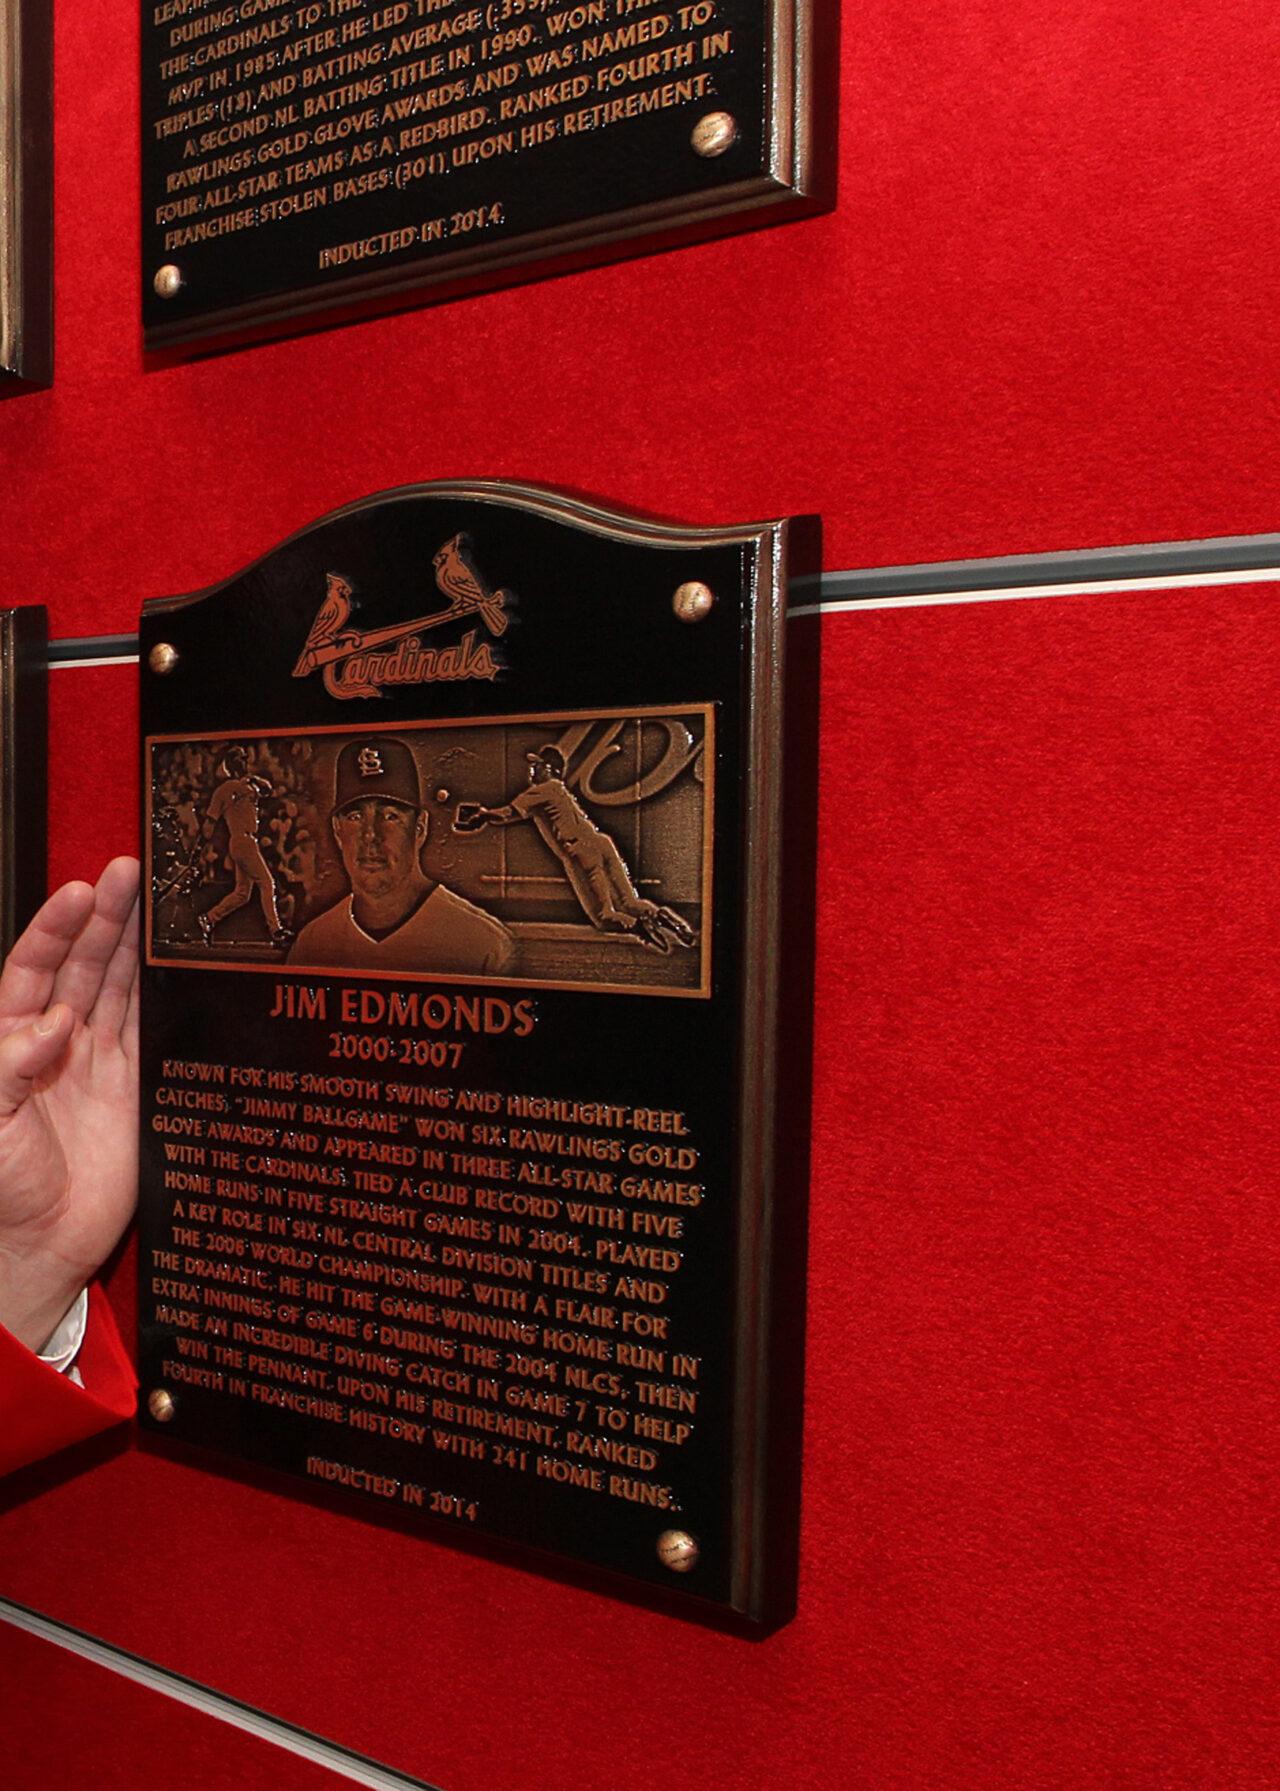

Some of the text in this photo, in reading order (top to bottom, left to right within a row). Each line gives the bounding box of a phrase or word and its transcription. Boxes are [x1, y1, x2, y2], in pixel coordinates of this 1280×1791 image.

[156, 196, 199, 224] FOUR
[204, 171, 280, 209] ALL-STAR
[285, 151, 344, 184] TEAMS
[350, 142, 373, 165] AS
[379, 137, 393, 156] A
[500, 76, 589, 119] RANKED
[597, 42, 695, 90] FOURTH
[702, 31, 731, 59] IN
[167, 1, 713, 192] RAWLINGS GOLD GLOVE AWARDS AND WAS NAMED TO
[165, 208, 255, 250] FRANCHISE
[260, 187, 327, 222] STOLEN
[333, 169, 388, 201] BASES
[395, 153, 445, 188] (301)
[452, 132, 513, 166] UPON
[520, 120, 555, 147] HIS
[319, 203, 501, 268] INDUCTED IN 2014
[323, 628, 501, 700] Cardinals
[271, 985, 534, 1035] JIM EDMONDS
[329, 1033, 463, 1068] 2000-2007
[162, 1060, 687, 1135] KNOWN FOR HIS SMOOTH SWING AND HIGHLIGHT-REEL
[415, 1118, 465, 1141] WON
[472, 1125, 501, 1146] SIX
[509, 1129, 622, 1161] RAWLINGS
[628, 1144, 697, 1170] GOLD
[152, 1115, 702, 1206] GLOVE AWARDS AND APPEARED IN THREE ALL-STAR GAMES
[164, 1144, 205, 1164] WITH
[210, 1151, 240, 1170] THE
[353, 1171, 393, 1193] TIED
[399, 1178, 413, 1197] A
[418, 1181, 469, 1205] CLUB
[475, 1189, 559, 1218] RECORD
[566, 1203, 624, 1229] WITH
[632, 1212, 682, 1238] FIVE
[165, 1171, 680, 1271] HOME RUNS IN FIVE STRAIGHT GAMES IN 2004. PLAYED
[173, 1200, 667, 1303] A KEY ROLE IN SIX NL CENTRAL DIVISION TITLES AND
[152, 1250, 179, 1271] THE
[280, 1276, 301, 1296] HE
[306, 1281, 335, 1302] HIT
[342, 1289, 374, 1311] THE
[380, 1298, 536, 1344] GAME-WINNING
[543, 1329, 610, 1360] HOME
[617, 1344, 664, 1372] RUN
[673, 1354, 698, 1379] IN
[172, 1227, 200, 1247] THE
[206, 1233, 245, 1256] 2006
[250, 1242, 314, 1269] WORLD
[473, 1284, 526, 1311] WITH
[534, 1296, 549, 1315] A
[556, 1299, 613, 1328] FLAIR
[622, 1312, 668, 1339] FOR
[152, 1278, 199, 1302] EXTRA
[204, 1288, 272, 1319] INNINGS
[277, 1305, 299, 1323] OF
[305, 1312, 357, 1337] GAME
[363, 1323, 374, 1341] 6
[380, 1327, 455, 1359] DURING
[463, 1344, 500, 1368] THE
[505, 1354, 557, 1382] 2004
[635, 1382, 697, 1413] THEN
[155, 1305, 690, 1444] MADE AN INCREDIBLE DIVING CATCH IN GAME 7 TO HELP
[163, 1361, 677, 1511] FOURTH IN FRANCHISE HISTORY WITH 241 HOME RUNS.
[176, 1337, 208, 1359] WIN
[215, 1346, 243, 1368] THE
[337, 1377, 389, 1404] UPON
[396, 1390, 425, 1413] HIS
[567, 1432, 657, 1470] RANKED
[307, 1457, 478, 1520] INDUCTED IN 2014
